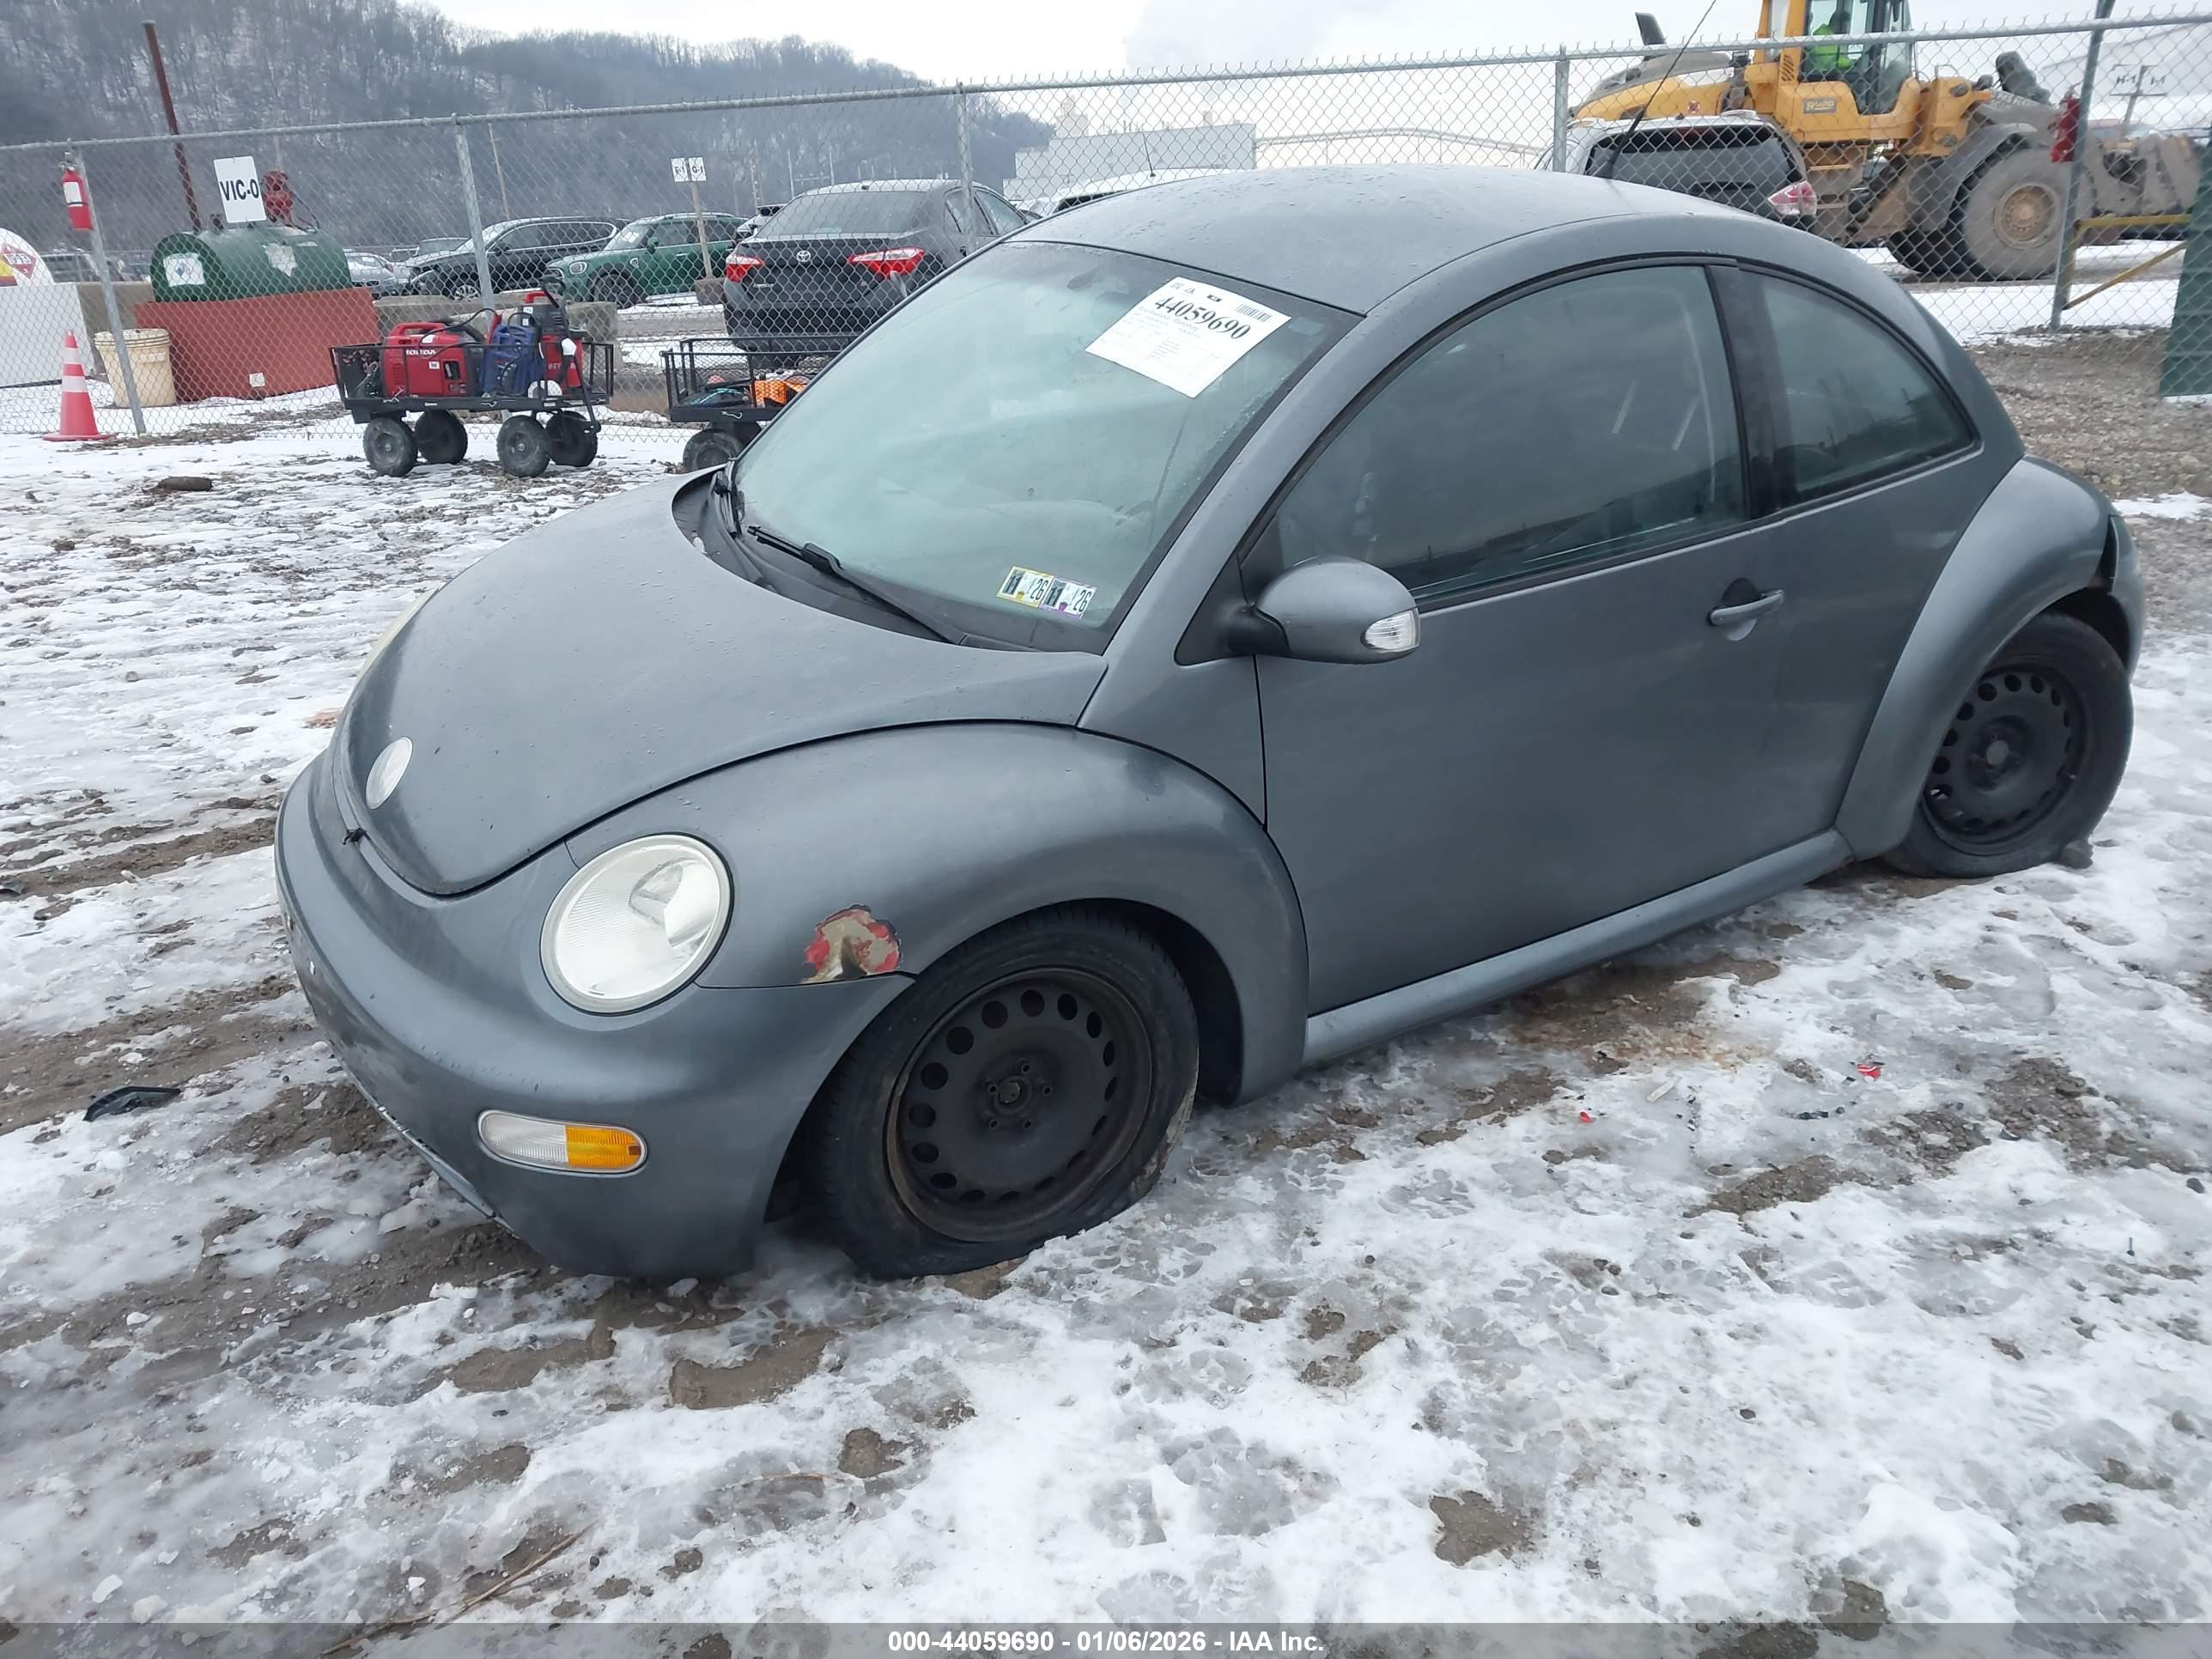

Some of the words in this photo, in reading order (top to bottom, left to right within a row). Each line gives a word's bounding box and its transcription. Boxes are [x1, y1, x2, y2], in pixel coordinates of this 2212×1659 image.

[2117, 75, 2136, 84] H-1
[691, 165, 703, 173] G-1
[1155, 295, 1251, 340] 44059690
[1005, 574, 1023, 594] 11
[1046, 586, 1064, 607] 11
